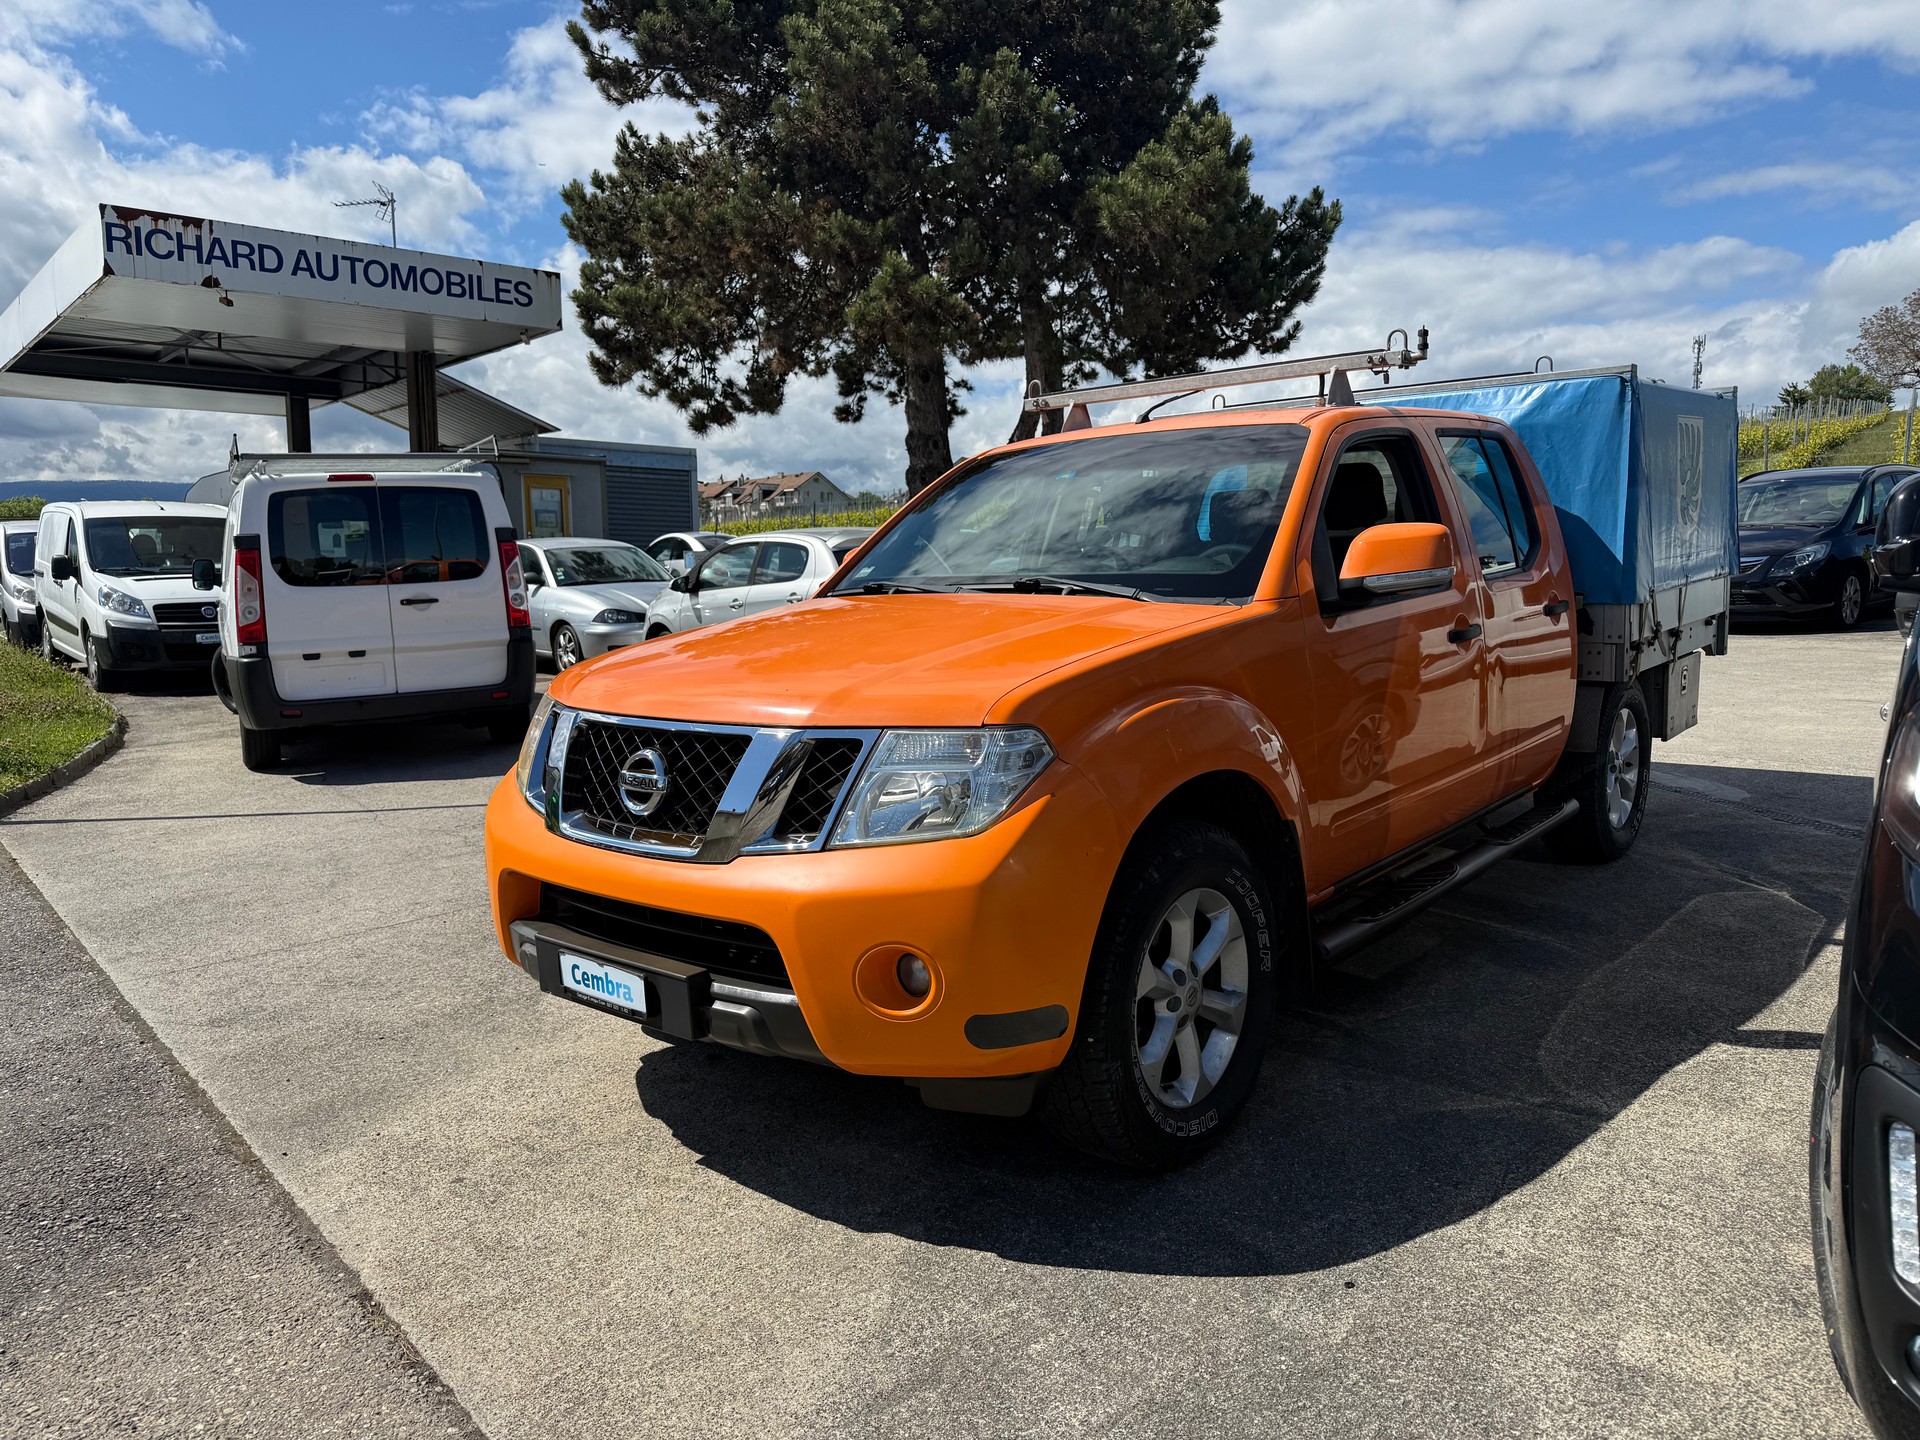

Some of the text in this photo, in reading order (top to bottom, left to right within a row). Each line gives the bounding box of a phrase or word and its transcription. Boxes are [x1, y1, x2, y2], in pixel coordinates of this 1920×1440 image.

[105, 221, 533, 308] RICHARD AUTOMOBILES
[620, 773, 657, 789] NISSAN
[1225, 868, 1272, 972] COOPER
[571, 963, 633, 1003] Cembra
